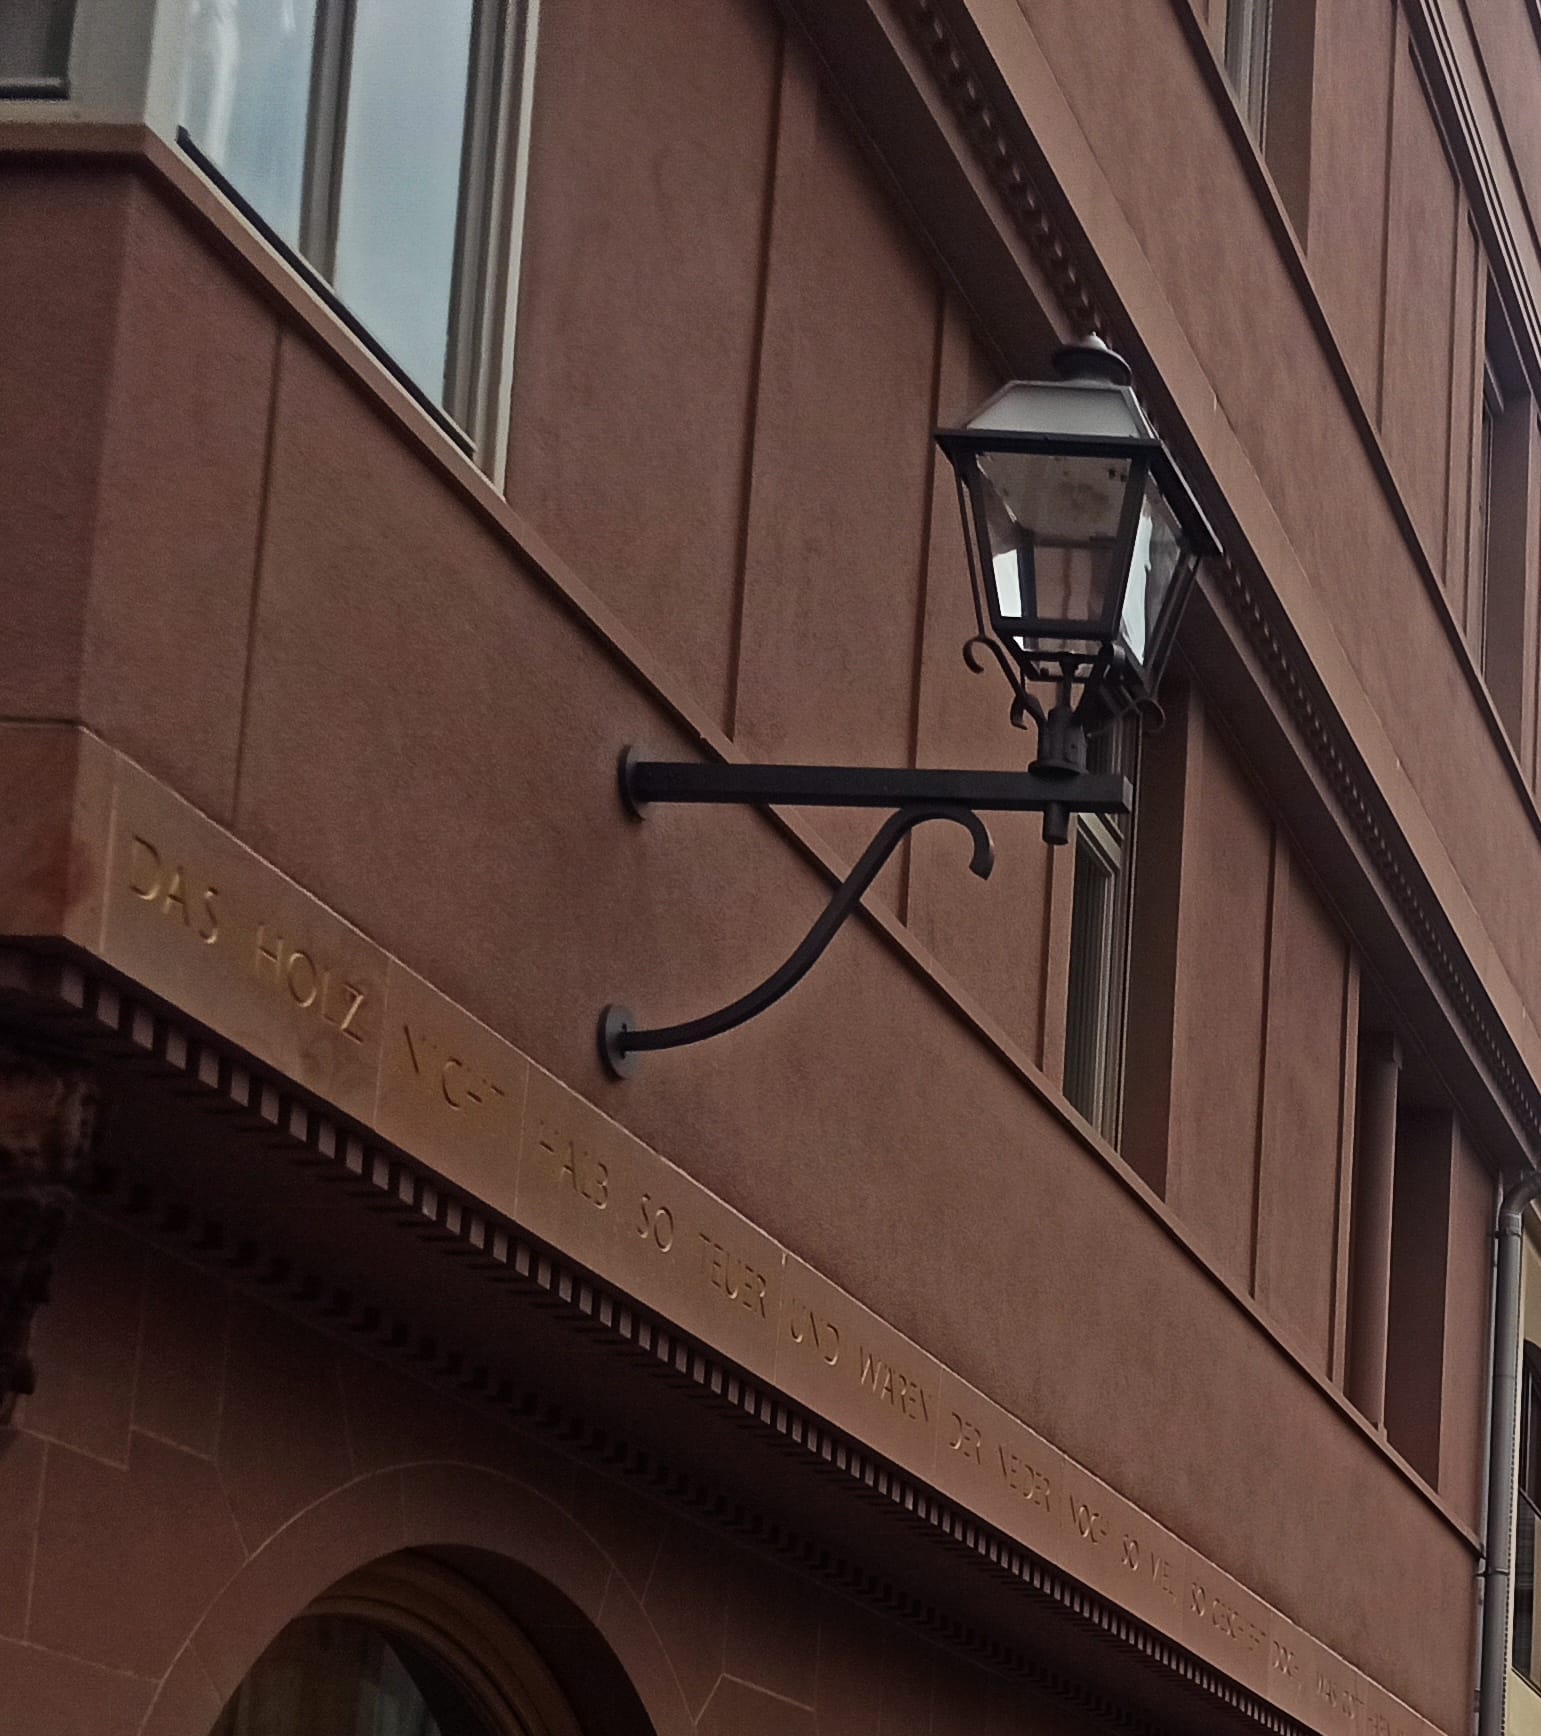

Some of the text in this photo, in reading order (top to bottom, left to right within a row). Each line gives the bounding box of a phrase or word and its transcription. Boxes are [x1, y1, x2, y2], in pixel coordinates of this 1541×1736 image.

[128, 832, 219, 946] DAS
[255, 922, 368, 1045] HOLZ
[400, 1022, 508, 1114] NCHT
[636, 1192, 675, 1253] SO
[698, 1232, 767, 1318] TEUER
[948, 1411, 982, 1464] DER
[997, 1444, 1051, 1512] NEDER
